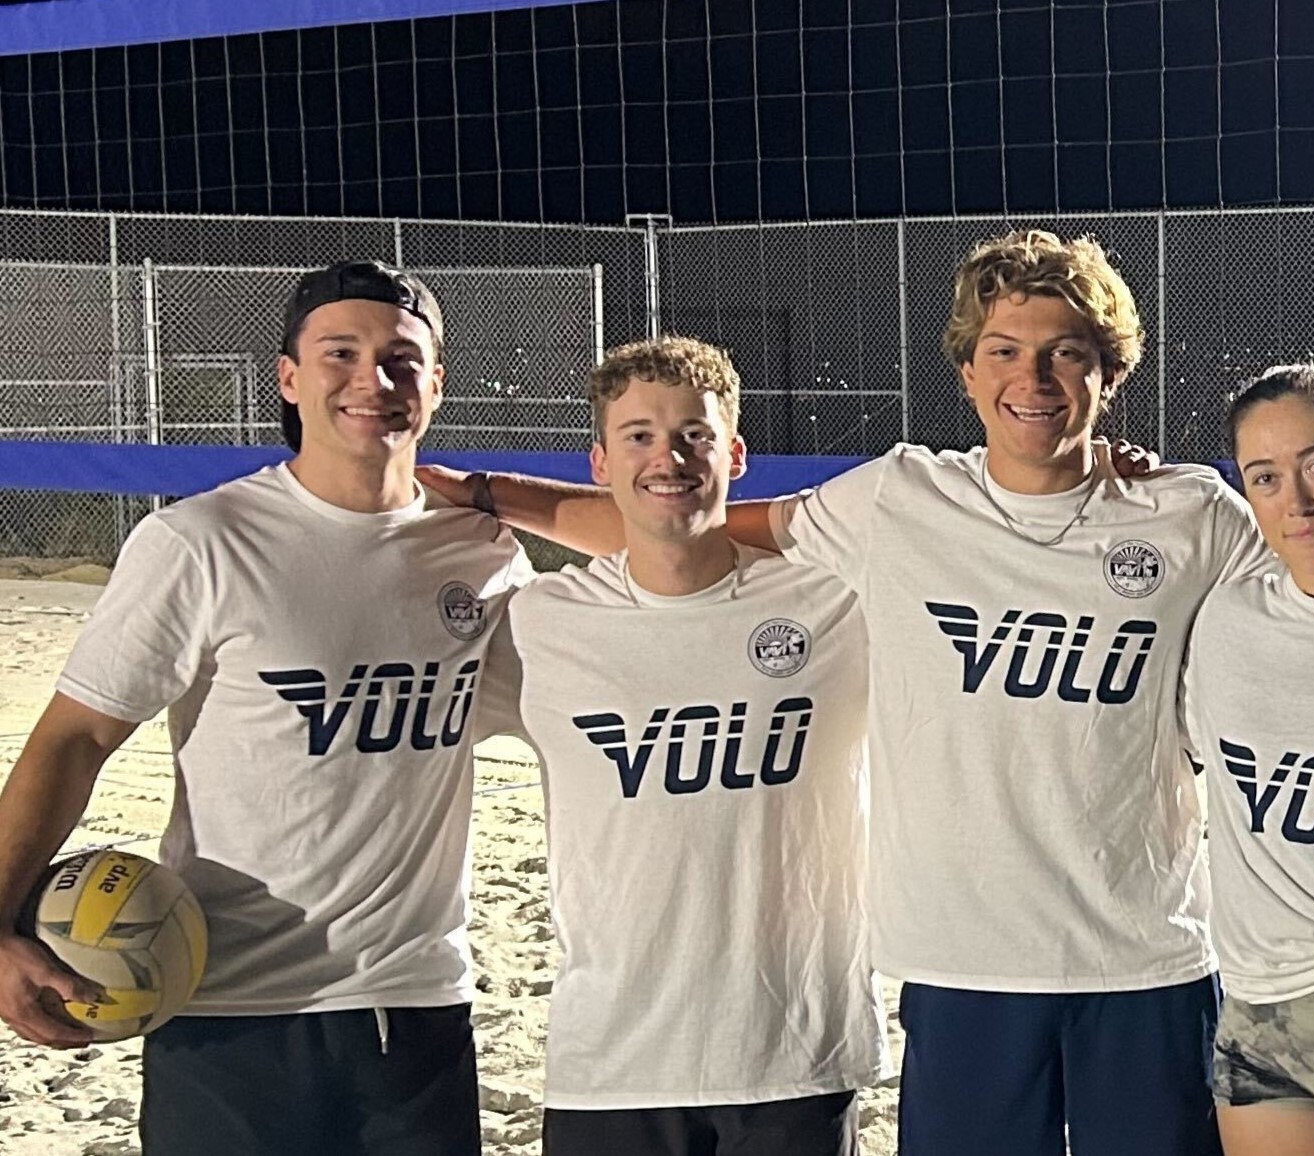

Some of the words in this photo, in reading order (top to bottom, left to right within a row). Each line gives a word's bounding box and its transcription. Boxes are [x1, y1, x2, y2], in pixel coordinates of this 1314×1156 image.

[925, 600, 1157, 705] VOLO
[257, 659, 480, 756] VOLO
[571, 697, 814, 798] VOLO
[98, 864, 130, 894] avp
